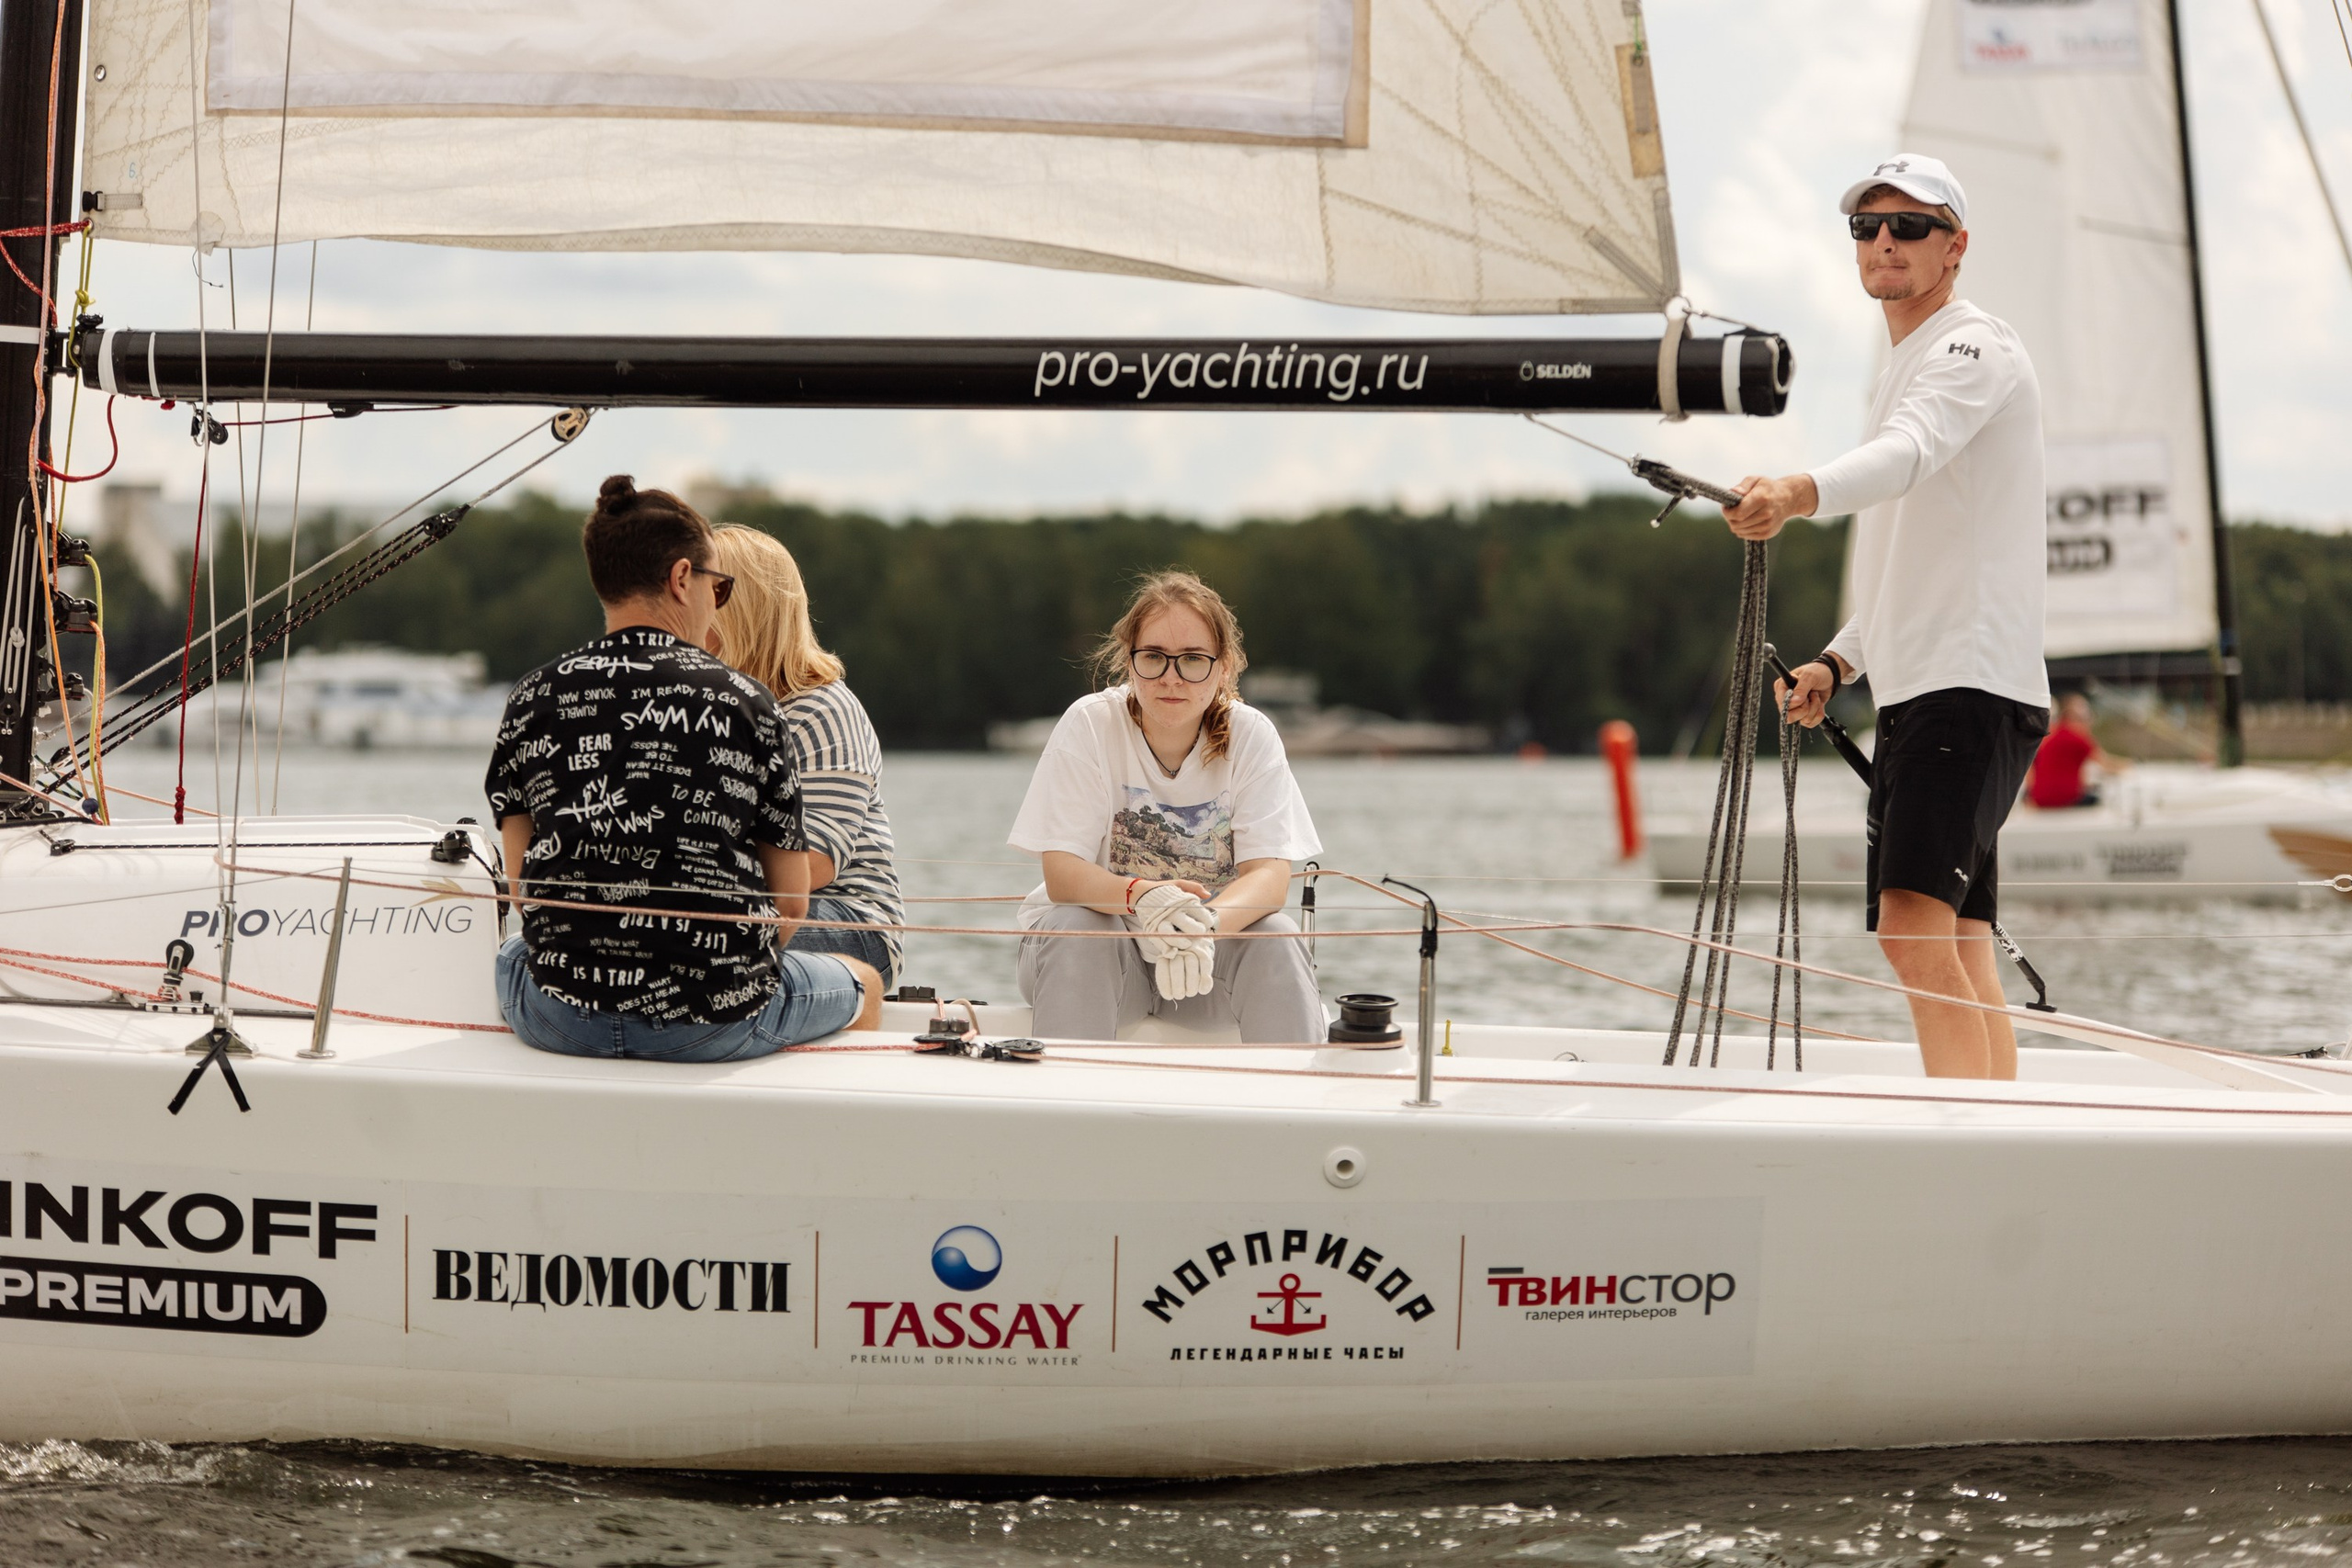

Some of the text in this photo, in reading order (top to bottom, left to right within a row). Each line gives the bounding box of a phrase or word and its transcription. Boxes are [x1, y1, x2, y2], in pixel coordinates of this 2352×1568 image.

[1948, 343, 1981, 360] HH
[1035, 343, 1429, 401] pro-yachting.ru
[657, 683, 696, 698] READY
[717, 691, 740, 706] GO
[578, 733, 613, 753] FEAR
[567, 752, 601, 772] LESS
[671, 784, 716, 808] TO BE
[676, 919, 690, 932] IS
[691, 931, 728, 954] LIFE
[537, 950, 569, 969] LIFE
[573, 965, 646, 987] IS A TRIP
[647, 976, 672, 989] WHAT
[616, 998, 641, 1012] DOES
[640, 993, 654, 1005] IT
[654, 985, 682, 1000] MEAN
[640, 1005, 656, 1016] TO
[432, 1249, 791, 1313] ВЕДОМОСТИ
[1141, 1229, 1436, 1324] МОРПРИБОР
[0, 1268, 302, 1325] PREMIUM
[846, 1301, 1086, 1349] TASSAY
[1525, 1306, 1678, 1323] галерея интерьеров
[851, 1354, 1080, 1366] PREMIUM DRINKING WATER
[1170, 1347, 1405, 1361] ЛЕГЕНДАРНЫЕ ЧАСЫ
